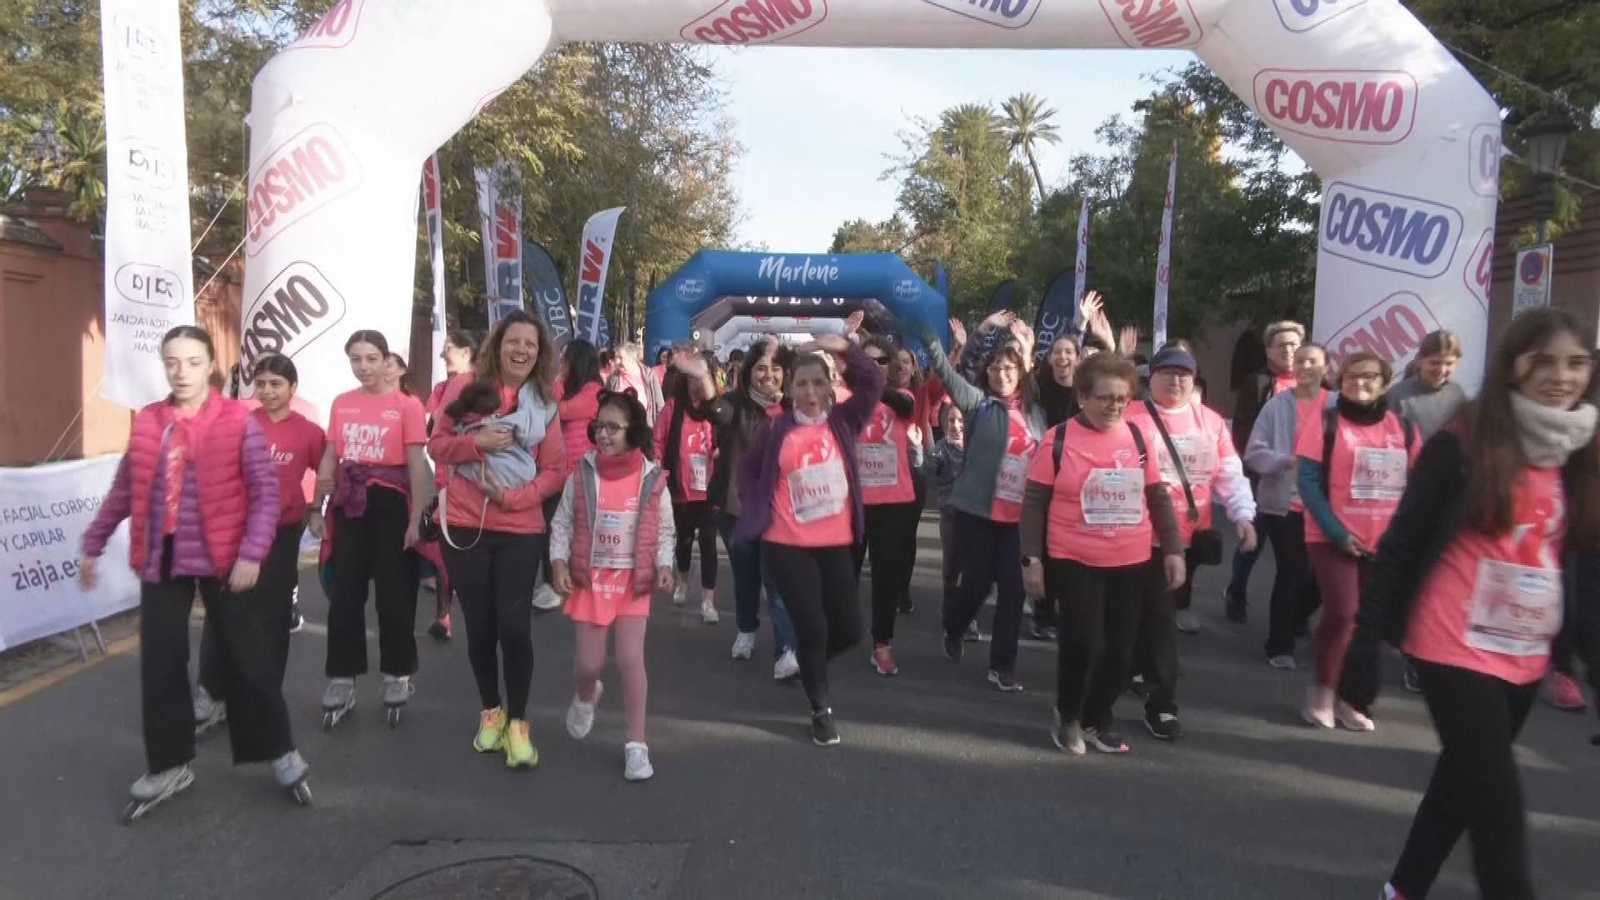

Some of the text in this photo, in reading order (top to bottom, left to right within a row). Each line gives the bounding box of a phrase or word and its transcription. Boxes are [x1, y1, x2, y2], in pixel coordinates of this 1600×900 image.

[1265, 78, 1404, 133] COSMO
[248, 136, 347, 242] COSMO
[1325, 192, 1450, 265] COSMO
[758, 255, 839, 293] Marlene
[543, 287, 569, 341] ABC
[1102, 491, 1127, 502] 016
[11, 528, 67, 551] CAPILAR
[599, 533, 621, 546] 016
